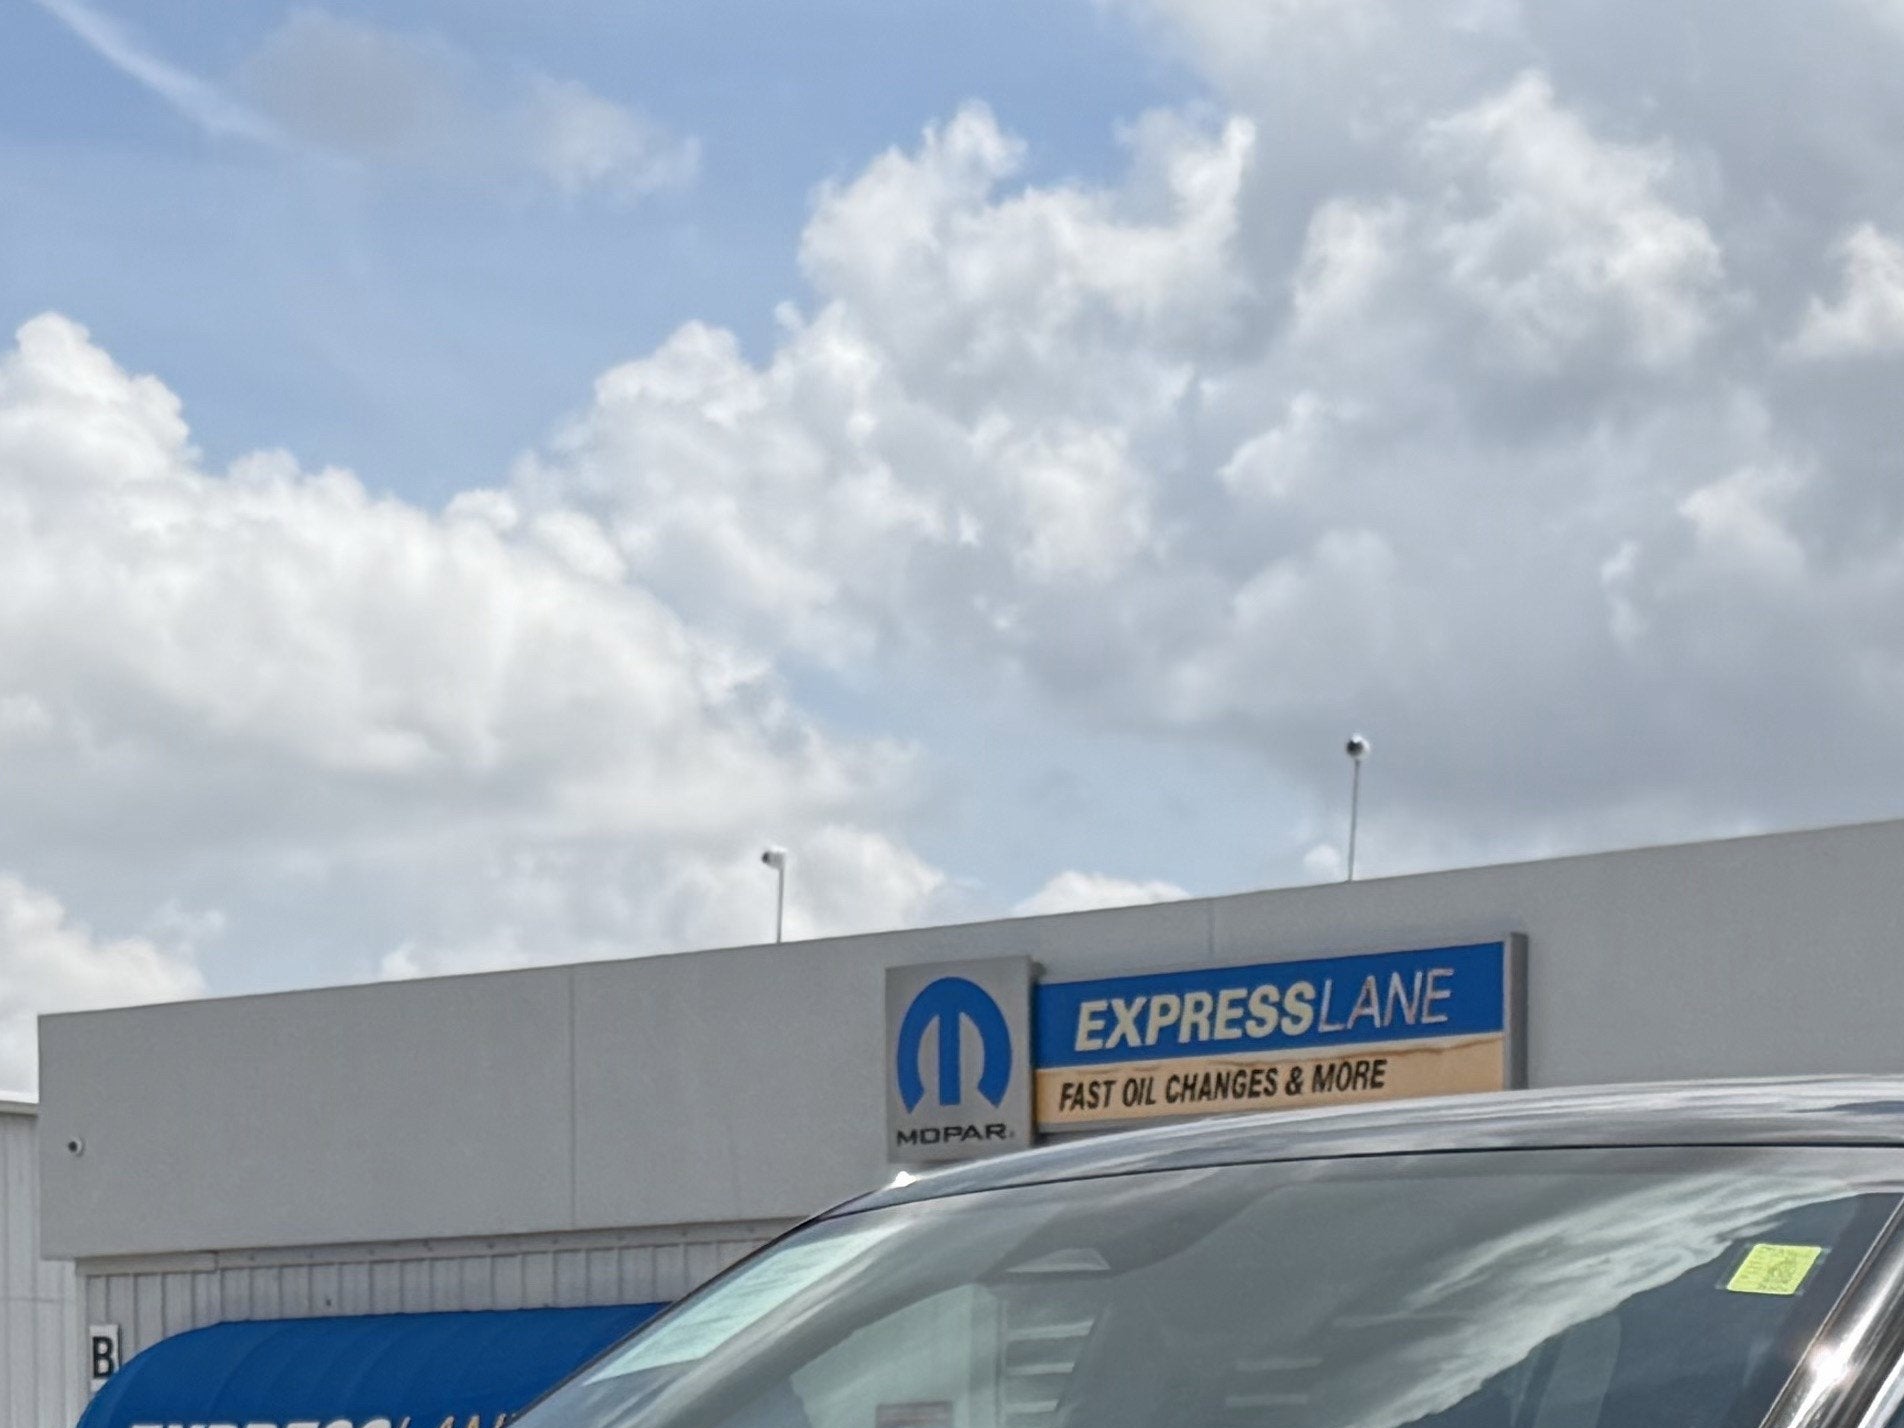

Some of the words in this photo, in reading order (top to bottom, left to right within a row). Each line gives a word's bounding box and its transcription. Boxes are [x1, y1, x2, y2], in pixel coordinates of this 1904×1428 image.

[1074, 968, 1455, 1052] EXPRESSLANE
[1059, 1080, 1117, 1112] FAST
[1122, 1076, 1156, 1107] OIL
[1165, 1067, 1279, 1101] CHANGES
[1284, 1065, 1304, 1097] &
[1312, 1058, 1388, 1093] MORE
[897, 1122, 1008, 1147] MOPAR
[92, 1336, 116, 1380] B
